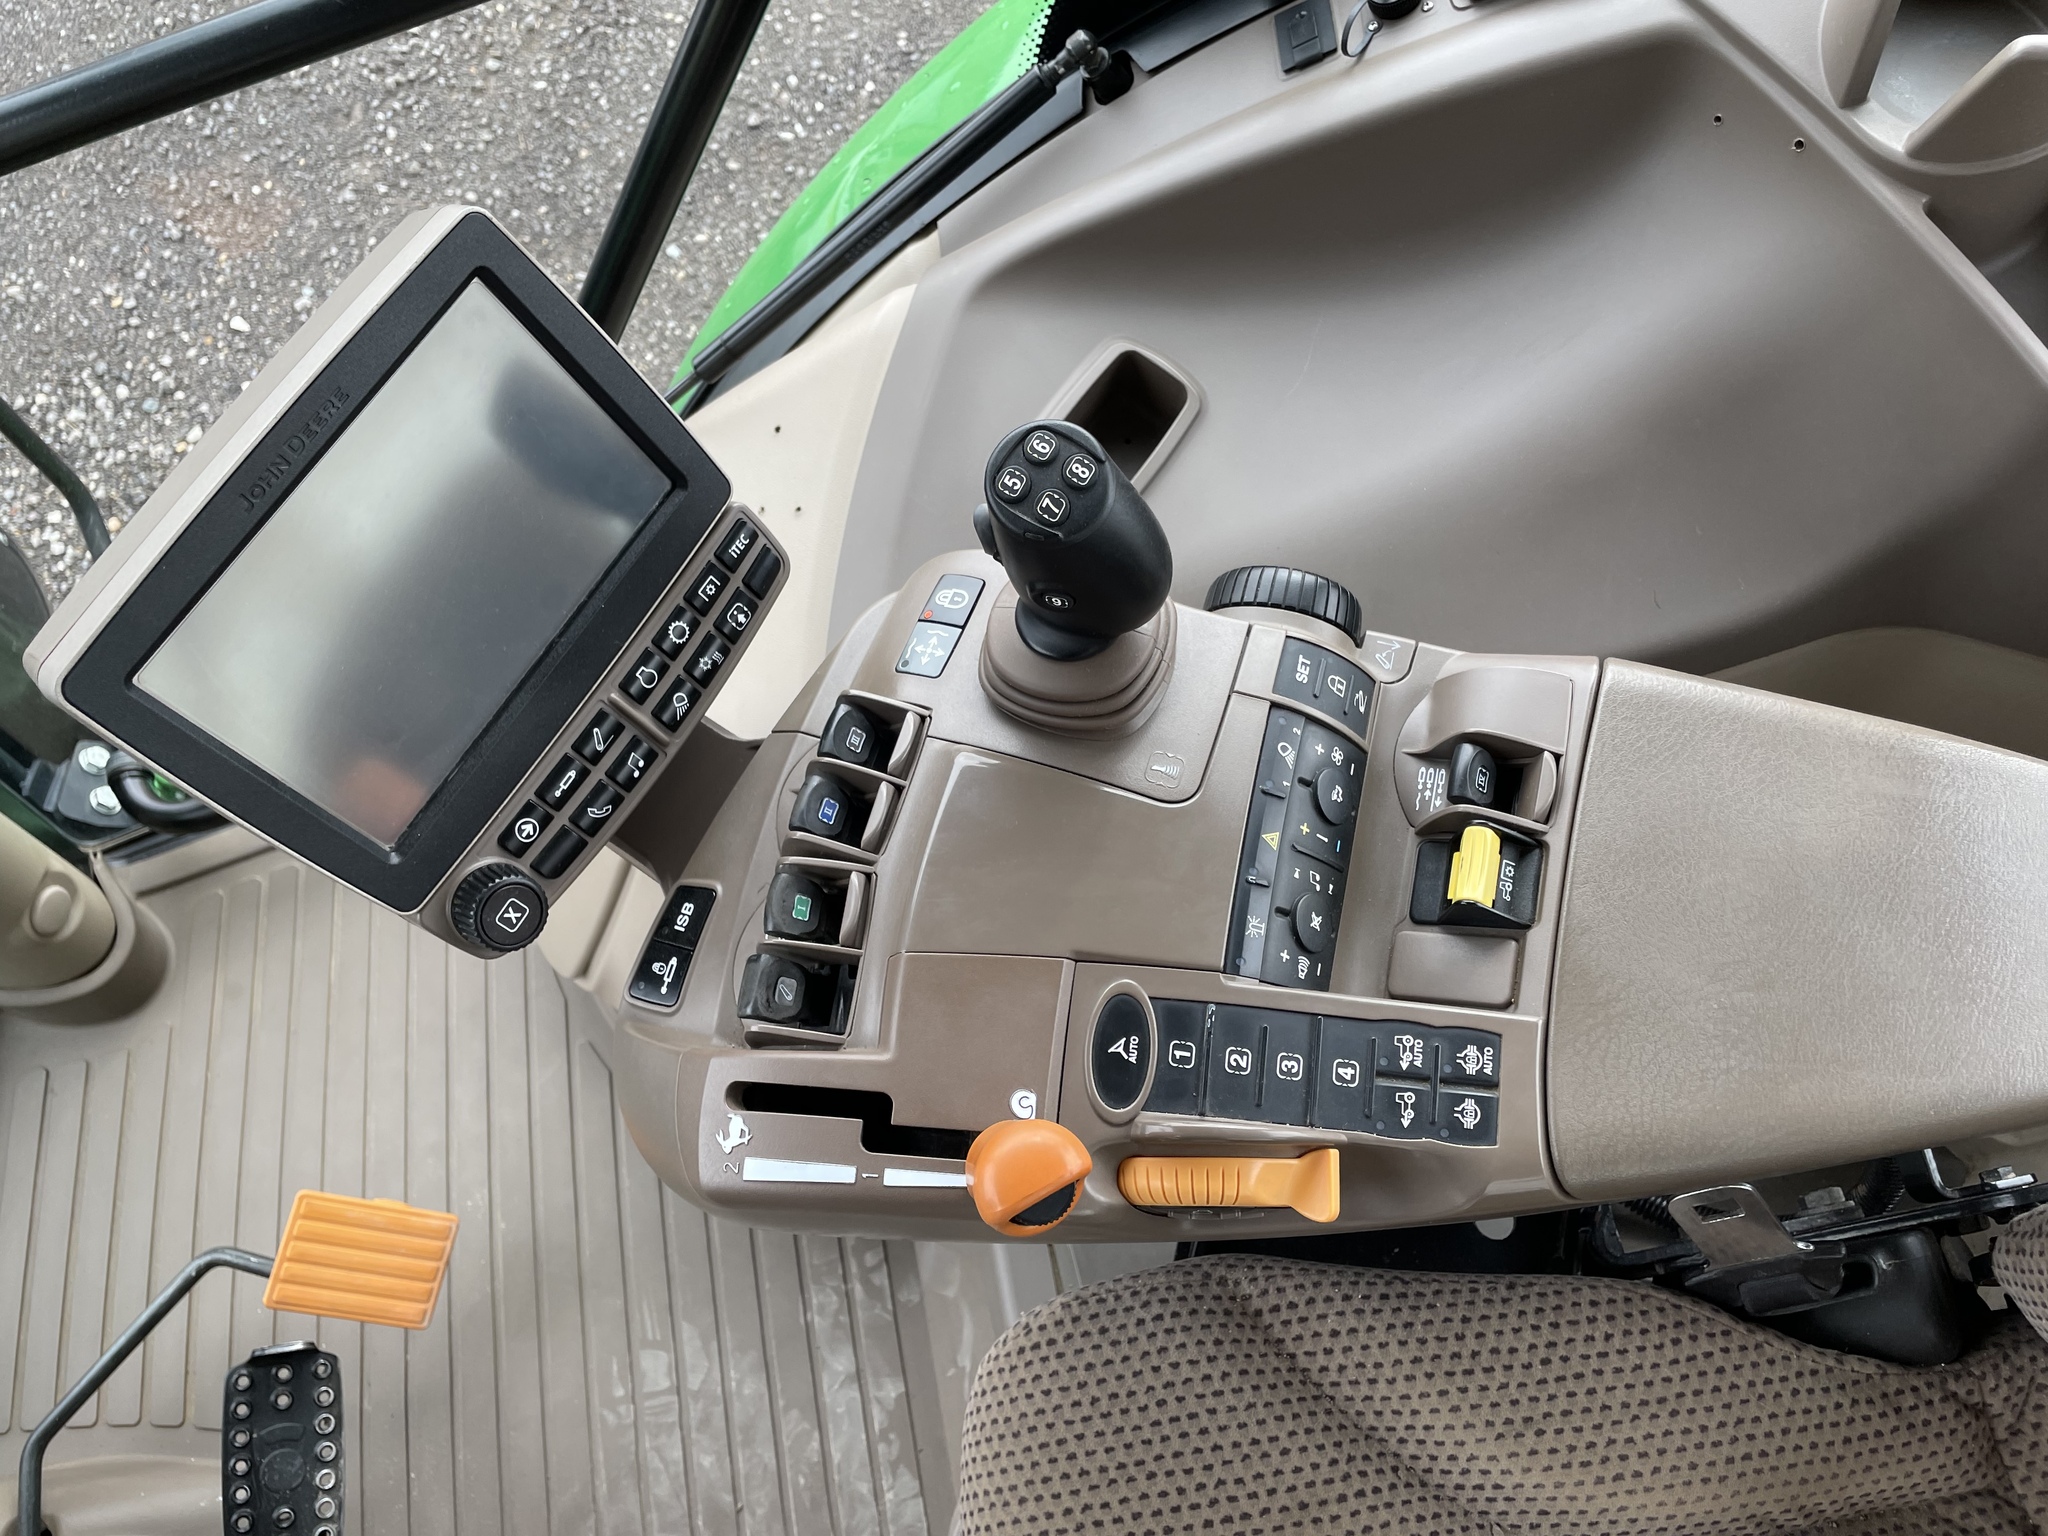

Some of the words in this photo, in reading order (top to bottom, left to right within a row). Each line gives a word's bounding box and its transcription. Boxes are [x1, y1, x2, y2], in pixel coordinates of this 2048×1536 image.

[239, 453, 292, 514] JOHN
[283, 386, 350, 459] DEERE
[1032, 439, 1050, 454] 6
[1071, 462, 1090, 479] 8
[1003, 475, 1022, 490] 5
[1042, 496, 1060, 515] 7
[728, 533, 750, 559] iTEC
[1295, 654, 1311, 684] SET
[673, 902, 695, 932] ISB
[1128, 1035, 1139, 1064] AUTO
[1174, 1047, 1192, 1061] 1
[1413, 1038, 1425, 1068] AUTO
[1230, 1052, 1249, 1070] 2
[1280, 1057, 1300, 1076] 3
[1482, 1046, 1494, 1076] AUTO
[1338, 1064, 1356, 1082] 4
[722, 1160, 740, 1175] 2
